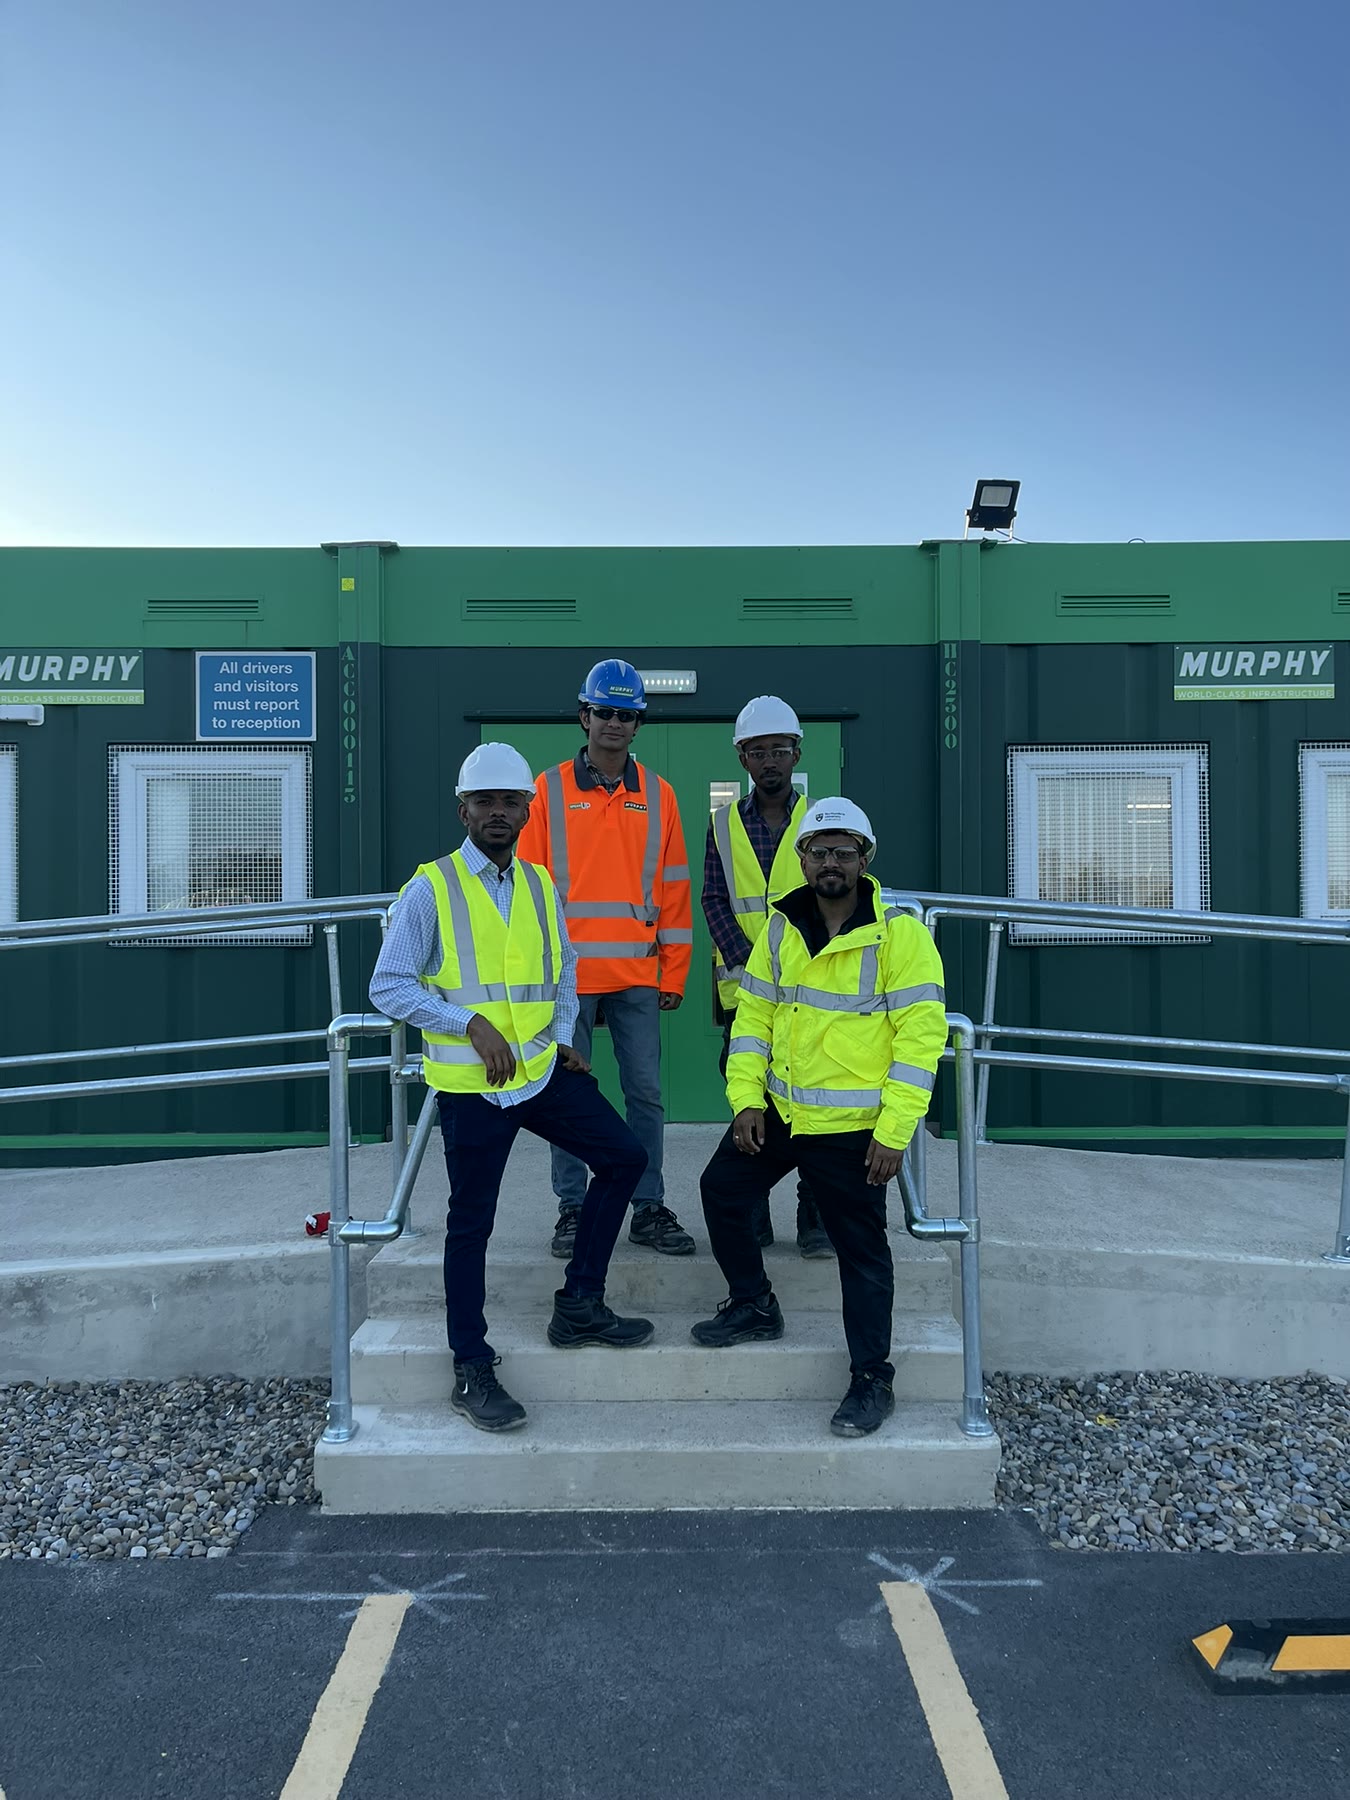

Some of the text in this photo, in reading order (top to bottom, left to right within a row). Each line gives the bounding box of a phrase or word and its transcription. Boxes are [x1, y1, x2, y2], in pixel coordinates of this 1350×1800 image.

[219, 661, 293, 674] All drivers
[1179, 650, 1330, 677] MURPHY
[213, 680, 299, 693] and visitors
[56, 695, 140, 703] INFRASTRUCTURE
[1178, 689, 1332, 699] WORLD-CLASS INFRASTRUCTURE
[213, 699, 300, 713] must report
[212, 716, 301, 731] to reception
[341, 645, 356, 803] ACC000115
